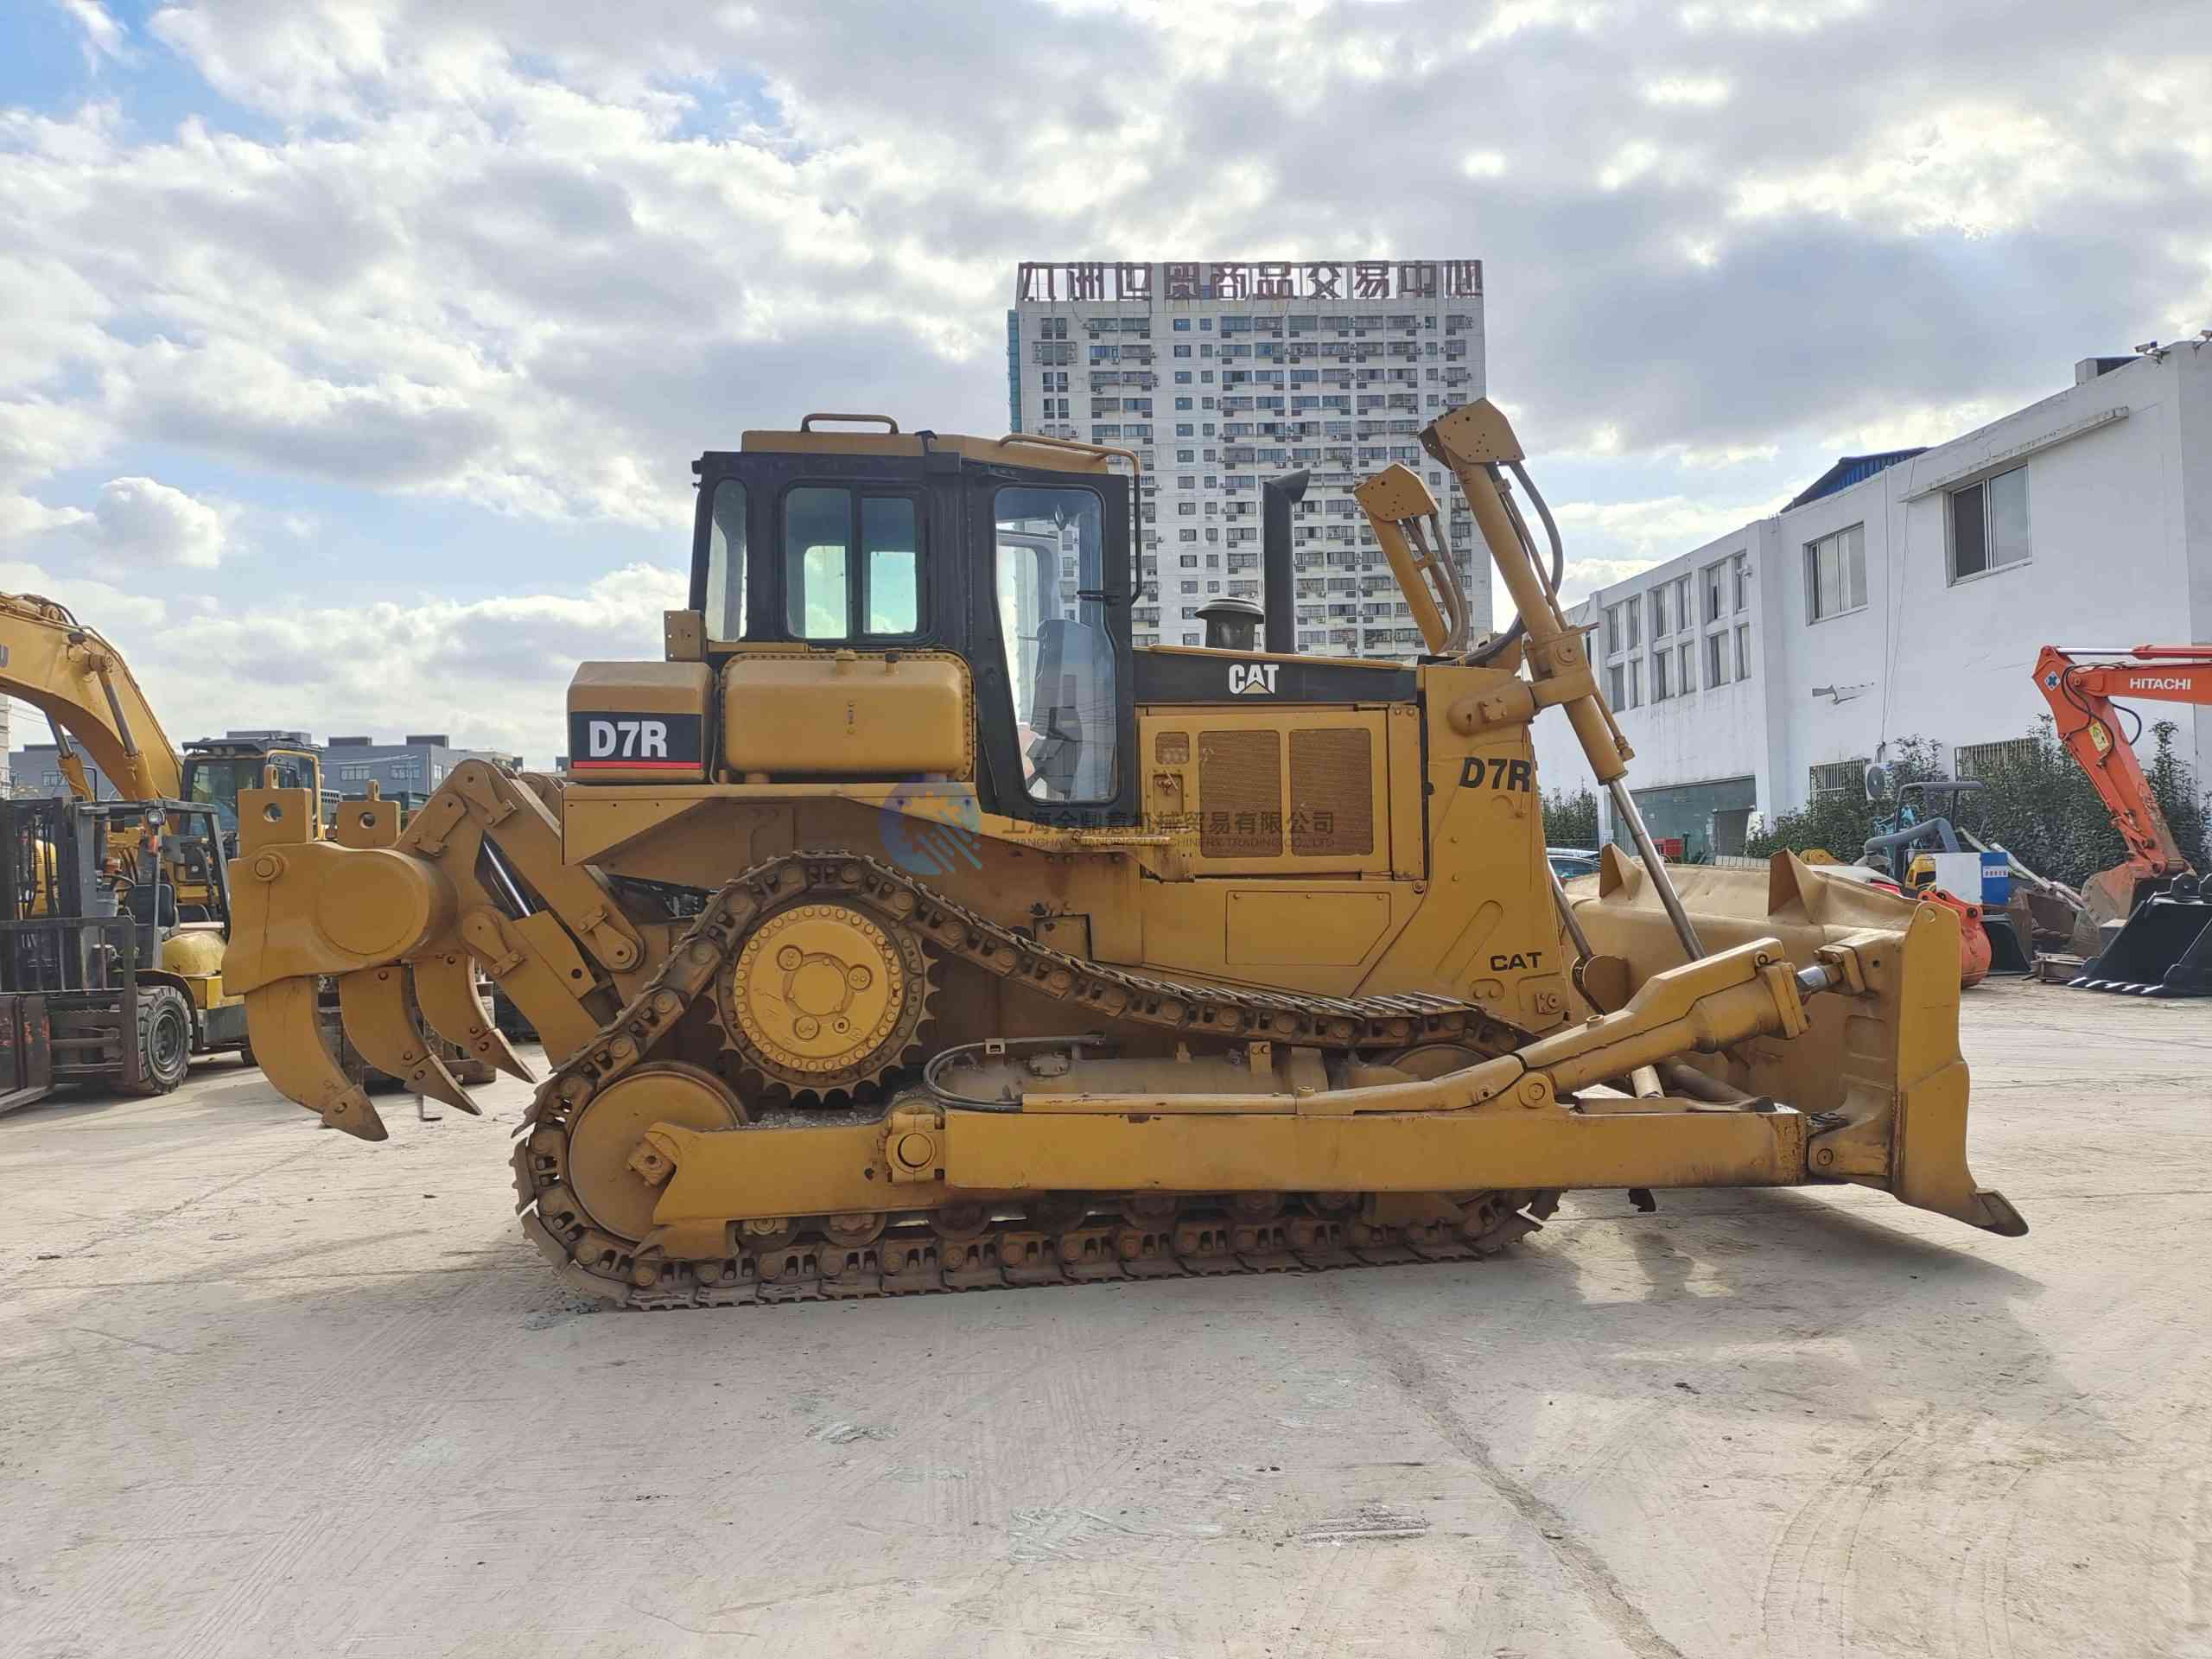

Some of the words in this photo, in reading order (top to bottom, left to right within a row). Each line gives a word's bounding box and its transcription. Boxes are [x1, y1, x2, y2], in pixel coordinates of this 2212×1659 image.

[1229, 664, 1280, 695] CAT
[2129, 677, 2192, 690] HITACHI
[589, 720, 668, 758] D7R
[1459, 757, 1532, 792] D7R
[1491, 951, 1541, 971] CAT
